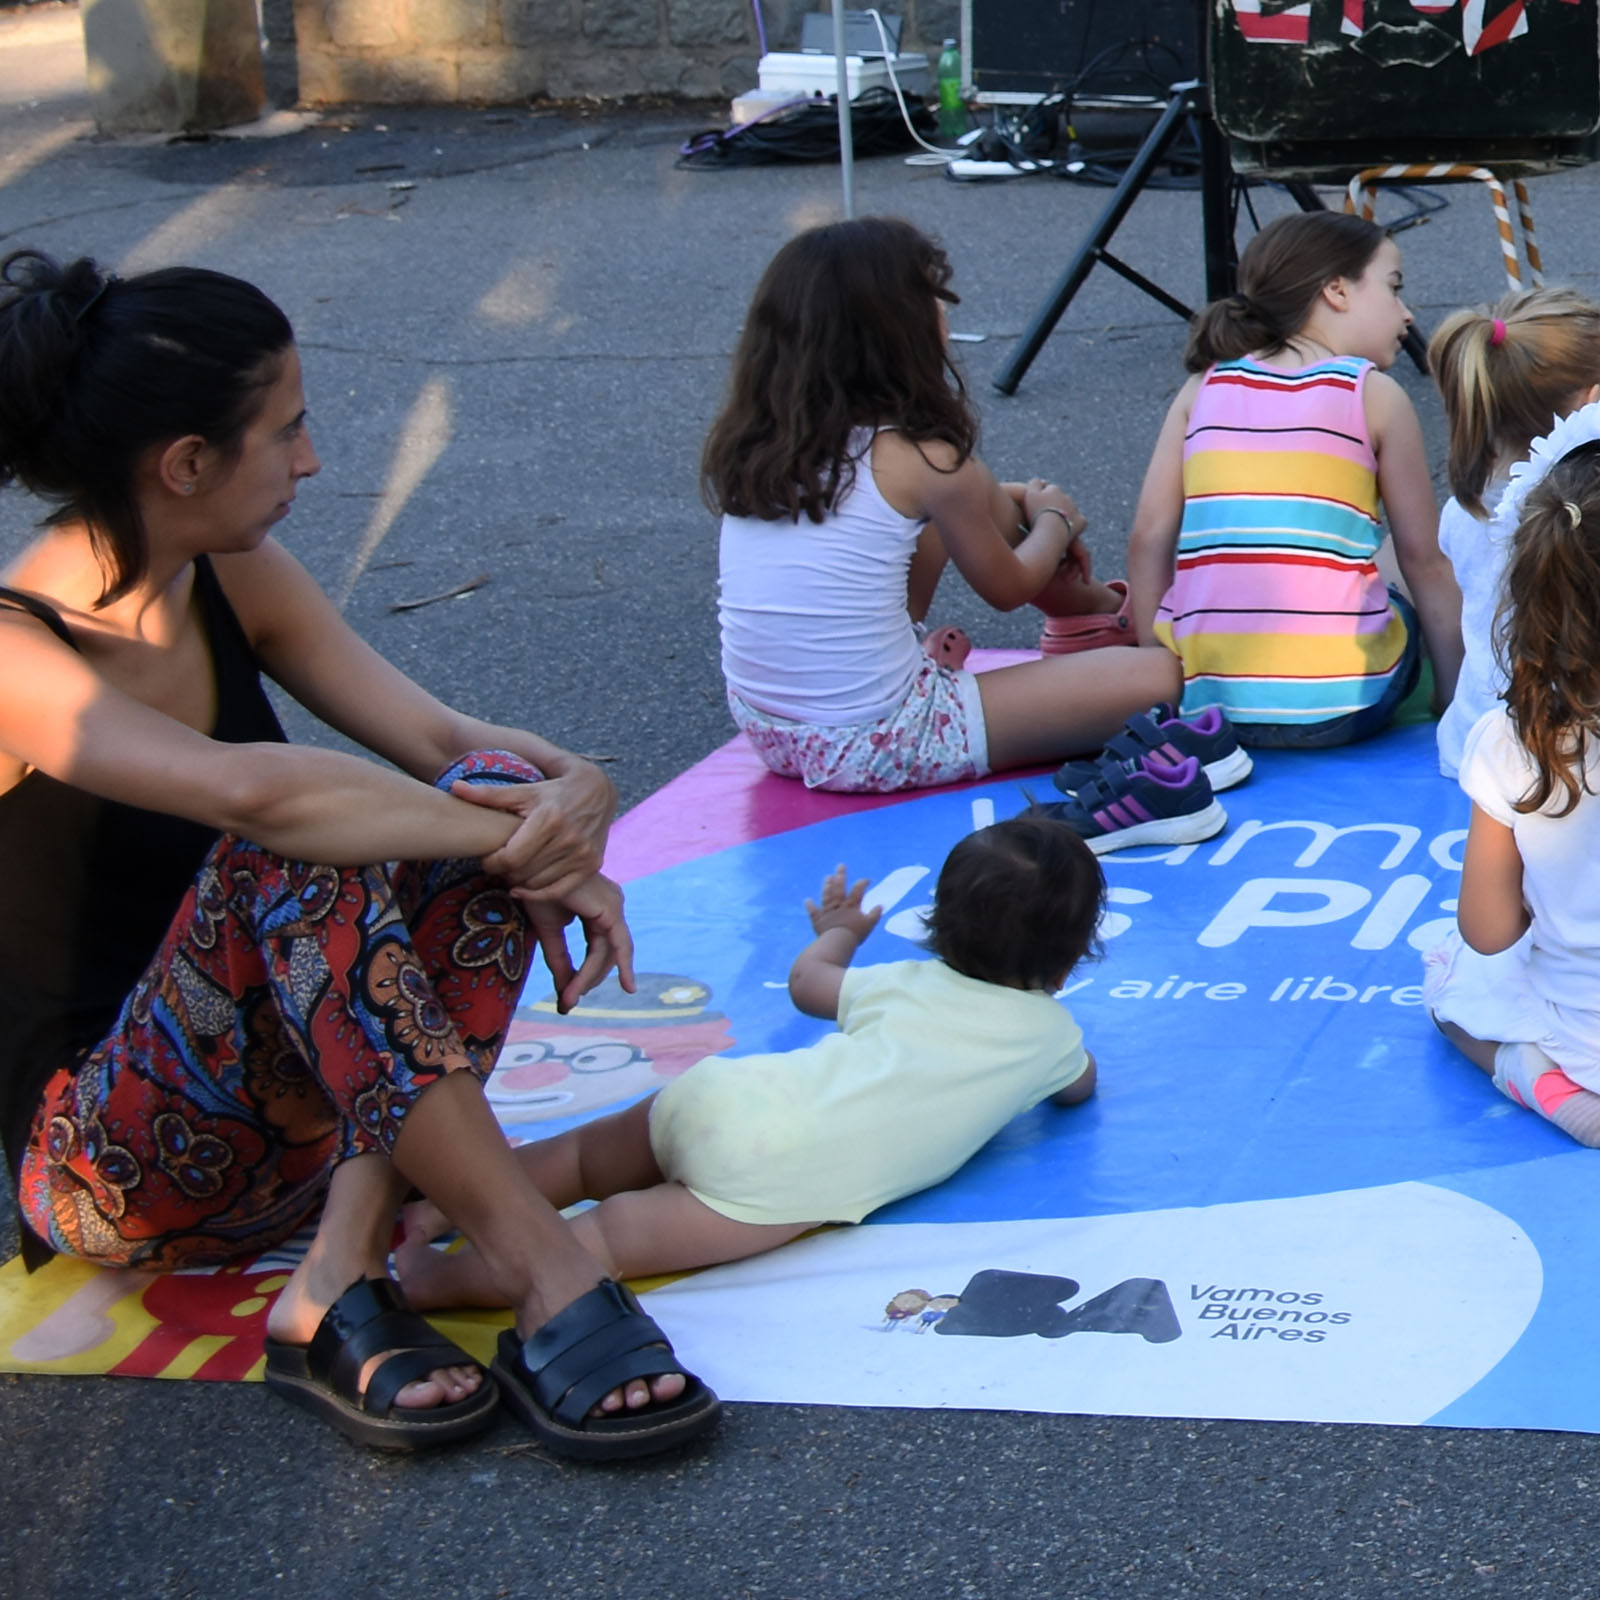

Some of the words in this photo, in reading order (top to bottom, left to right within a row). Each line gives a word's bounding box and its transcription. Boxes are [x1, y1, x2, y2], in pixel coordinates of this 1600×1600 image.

[1109, 975, 1247, 1001] aire
[1269, 975, 1424, 1006] libre
[1189, 1284, 1325, 1305] Vamos
[934, 1268, 1183, 1344] BA
[1198, 1303, 1352, 1325] Buenos
[1210, 1322, 1328, 1343] Aires
